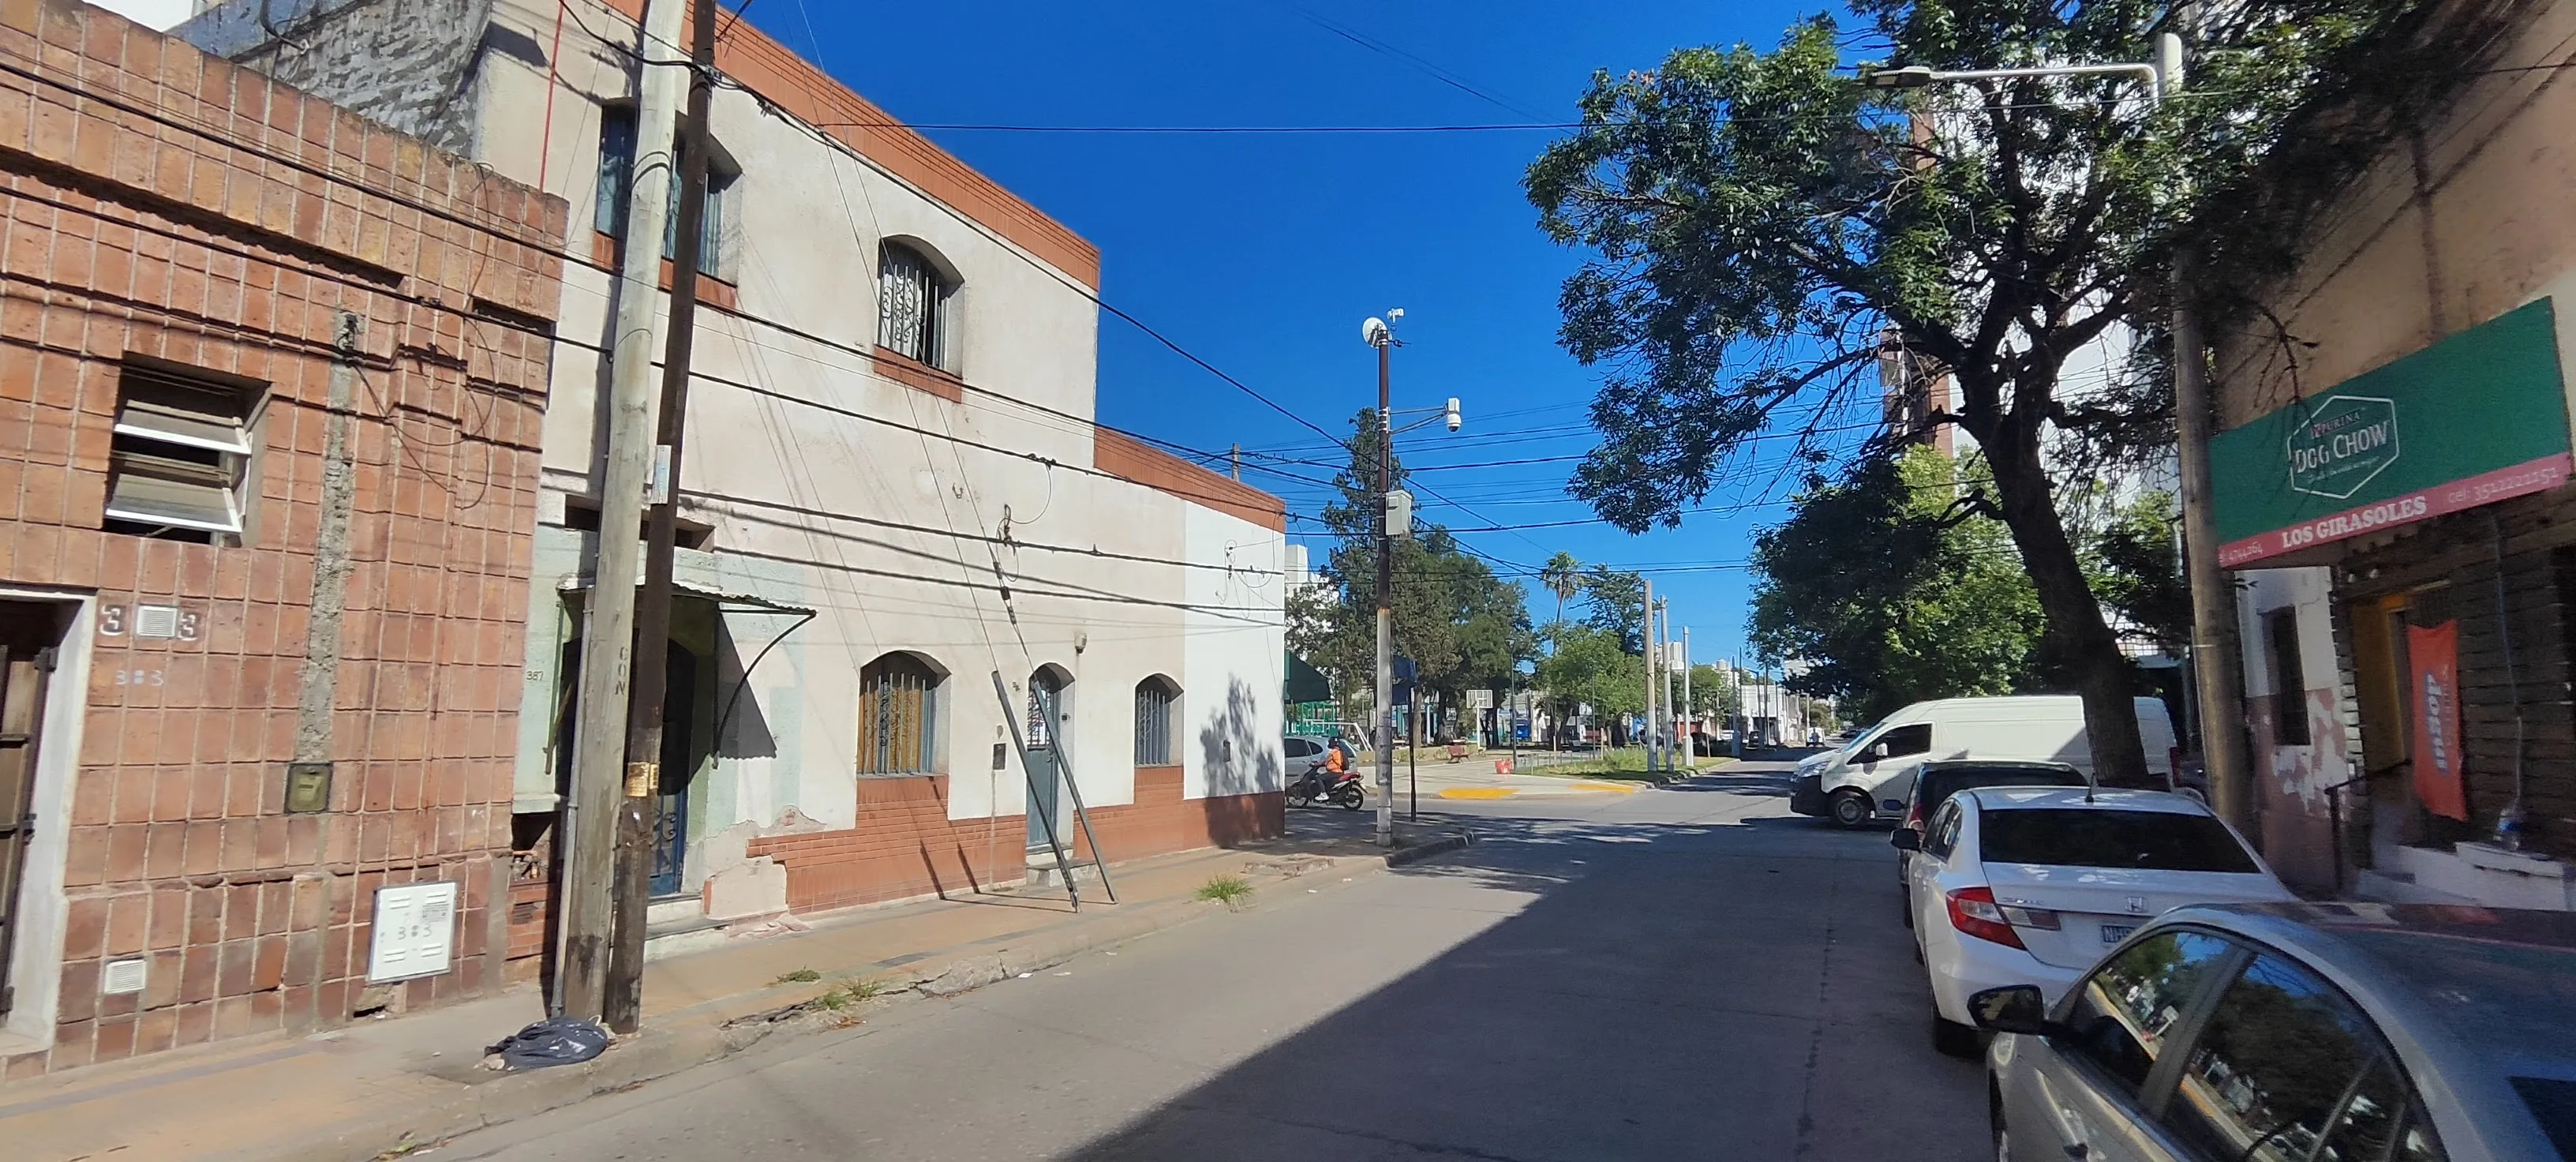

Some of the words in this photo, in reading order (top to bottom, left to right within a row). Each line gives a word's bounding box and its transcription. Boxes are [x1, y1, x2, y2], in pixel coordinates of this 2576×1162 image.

[2294, 444, 2330, 474] DOG
[2333, 421, 2390, 459] CHOW
[2282, 526, 2314, 549] LOS
[2316, 496, 2428, 539] GIRASOLES
